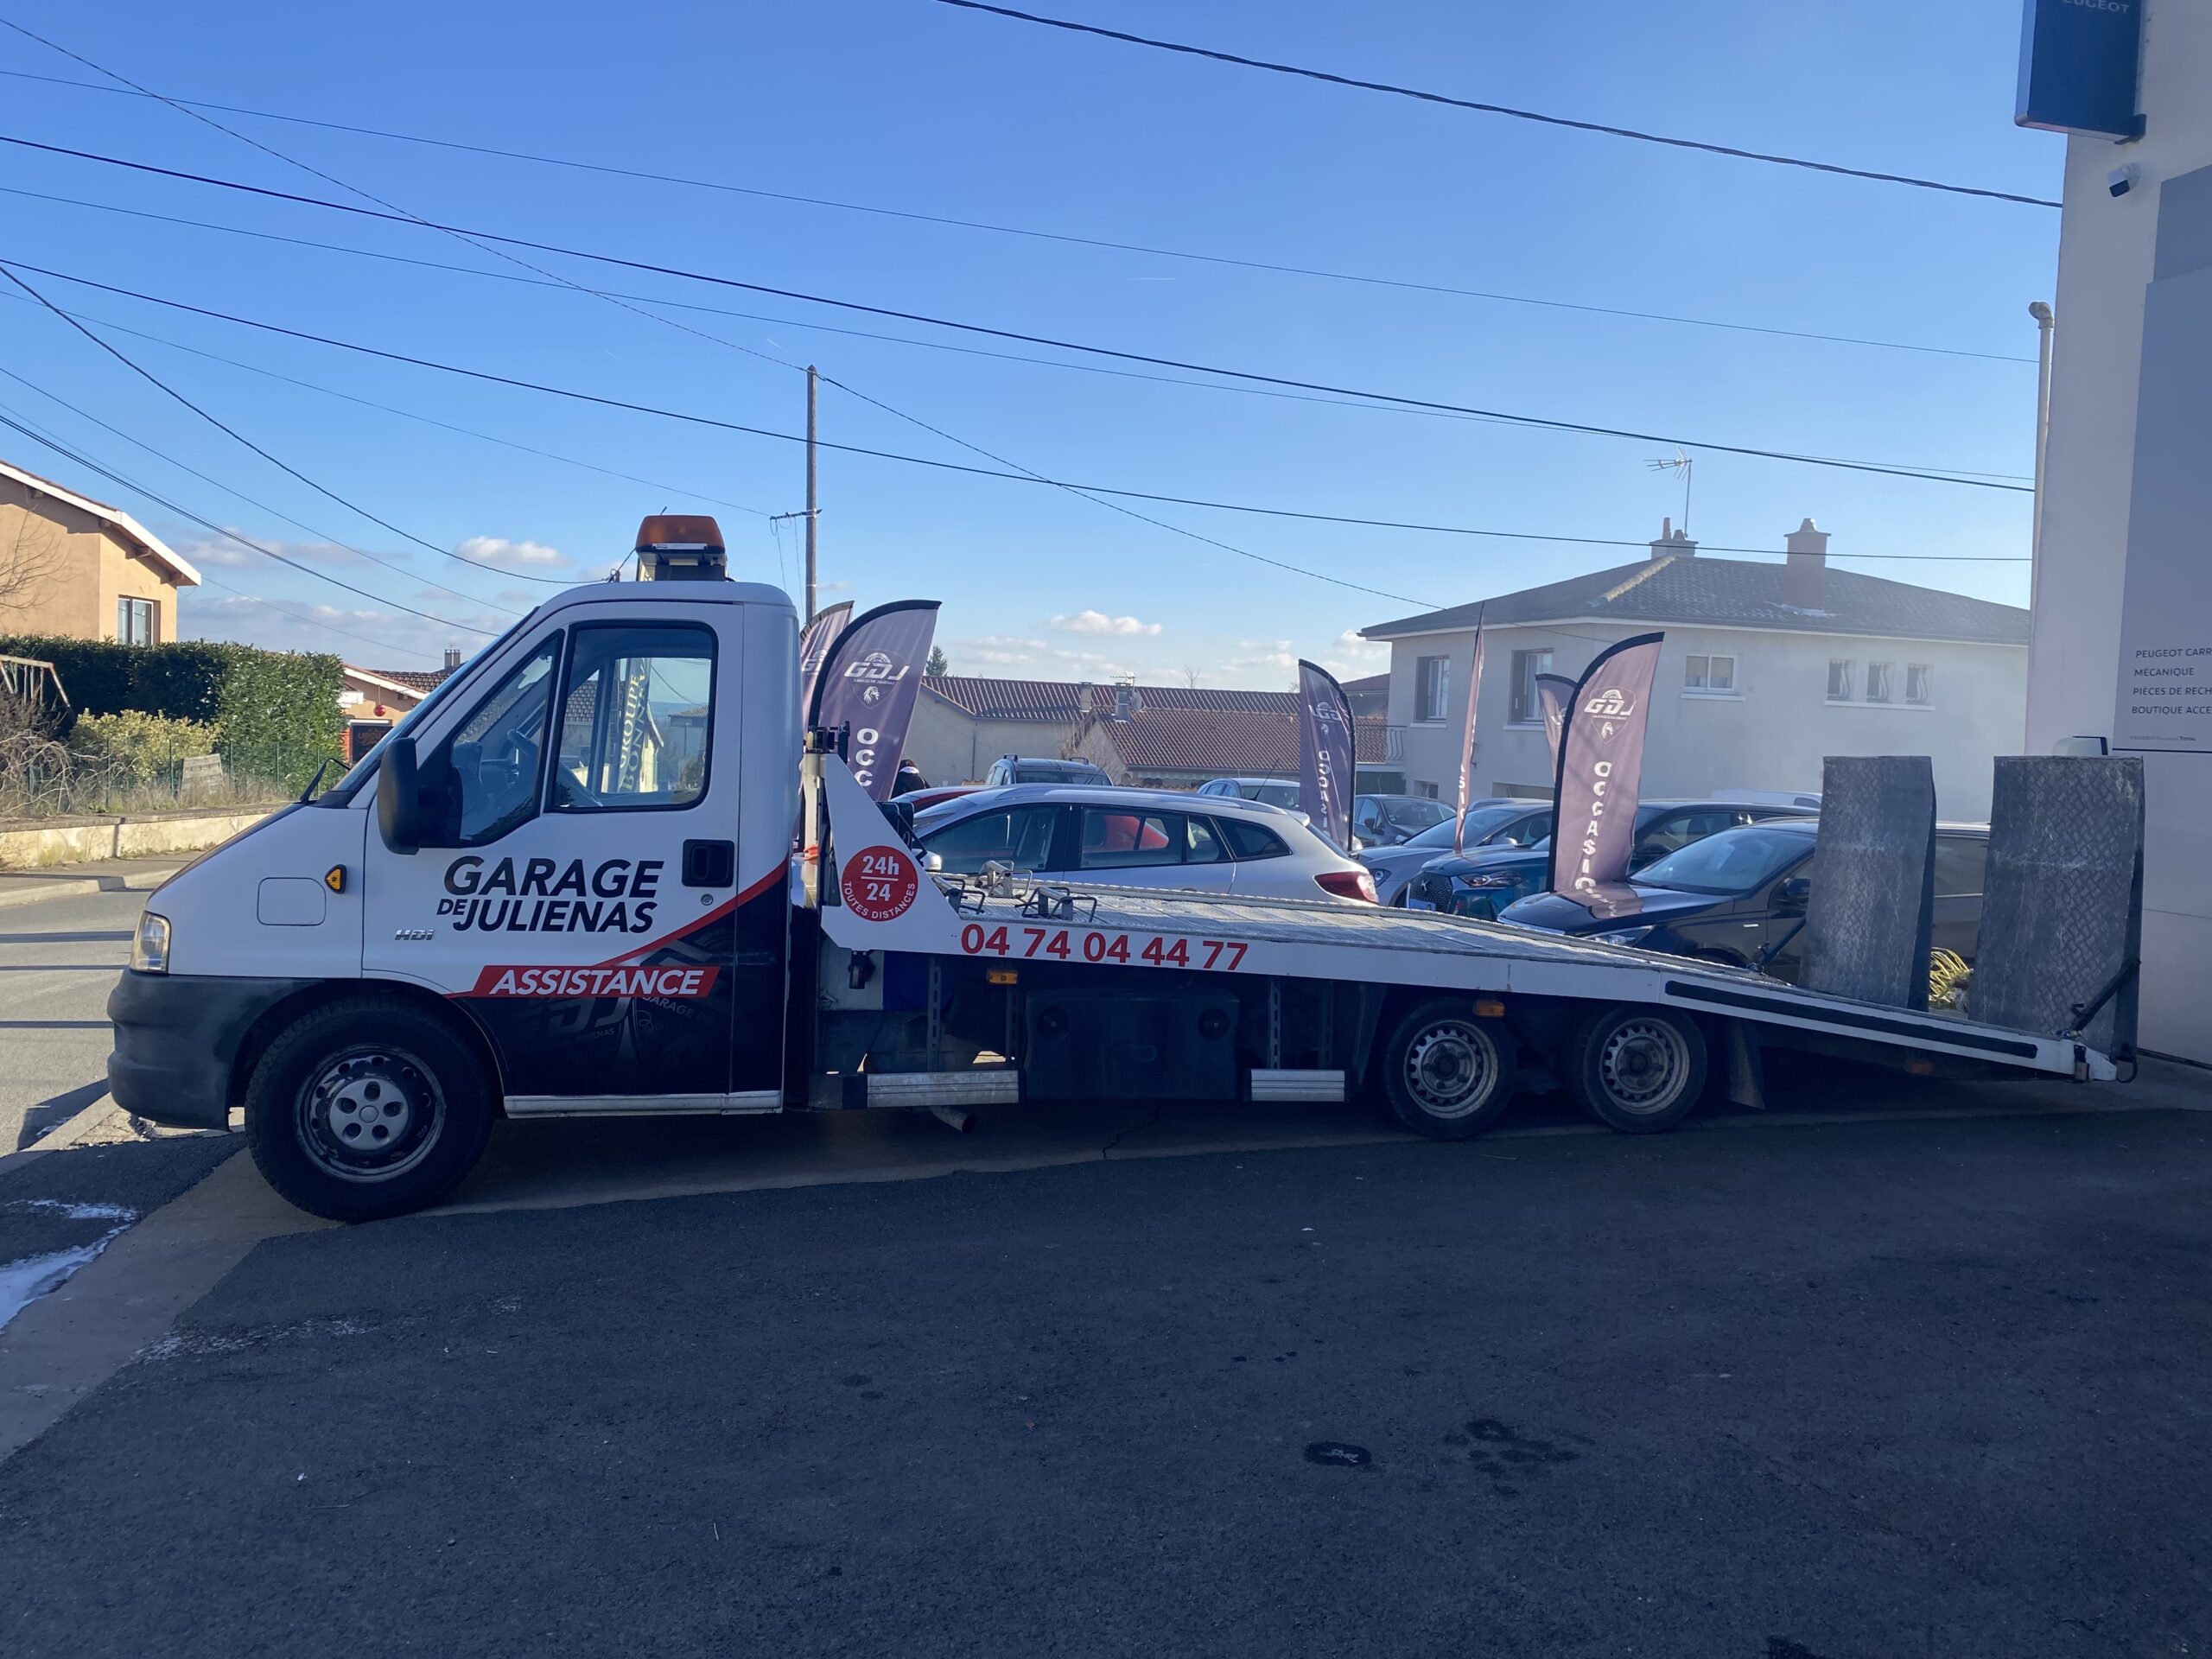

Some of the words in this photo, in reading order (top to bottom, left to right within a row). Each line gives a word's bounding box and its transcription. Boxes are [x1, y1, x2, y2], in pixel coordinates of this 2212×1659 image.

[2135, 648, 2183, 658] PEUGEOT
[2185, 647, 2212, 657] CARR
[843, 661, 911, 681] GDJ
[2169, 687, 2183, 696] DE
[1584, 698, 1637, 716] GDJ
[2132, 706, 2184, 715] BOUTIQUE
[861, 855, 899, 875] 24h
[443, 855, 664, 899] GARAGE
[843, 881, 869, 916] TOUTES
[871, 883, 916, 919] DISTANCES
[866, 882, 891, 902] 24
[436, 899, 467, 916] DE
[453, 899, 658, 934] JULIENAS
[961, 924, 1010, 956] 04
[1023, 928, 1071, 959] 74
[1084, 931, 1131, 963] 04
[1141, 937, 1190, 968] 44
[1202, 940, 1249, 970] 77
[488, 969, 705, 995] ASSISTANCE
